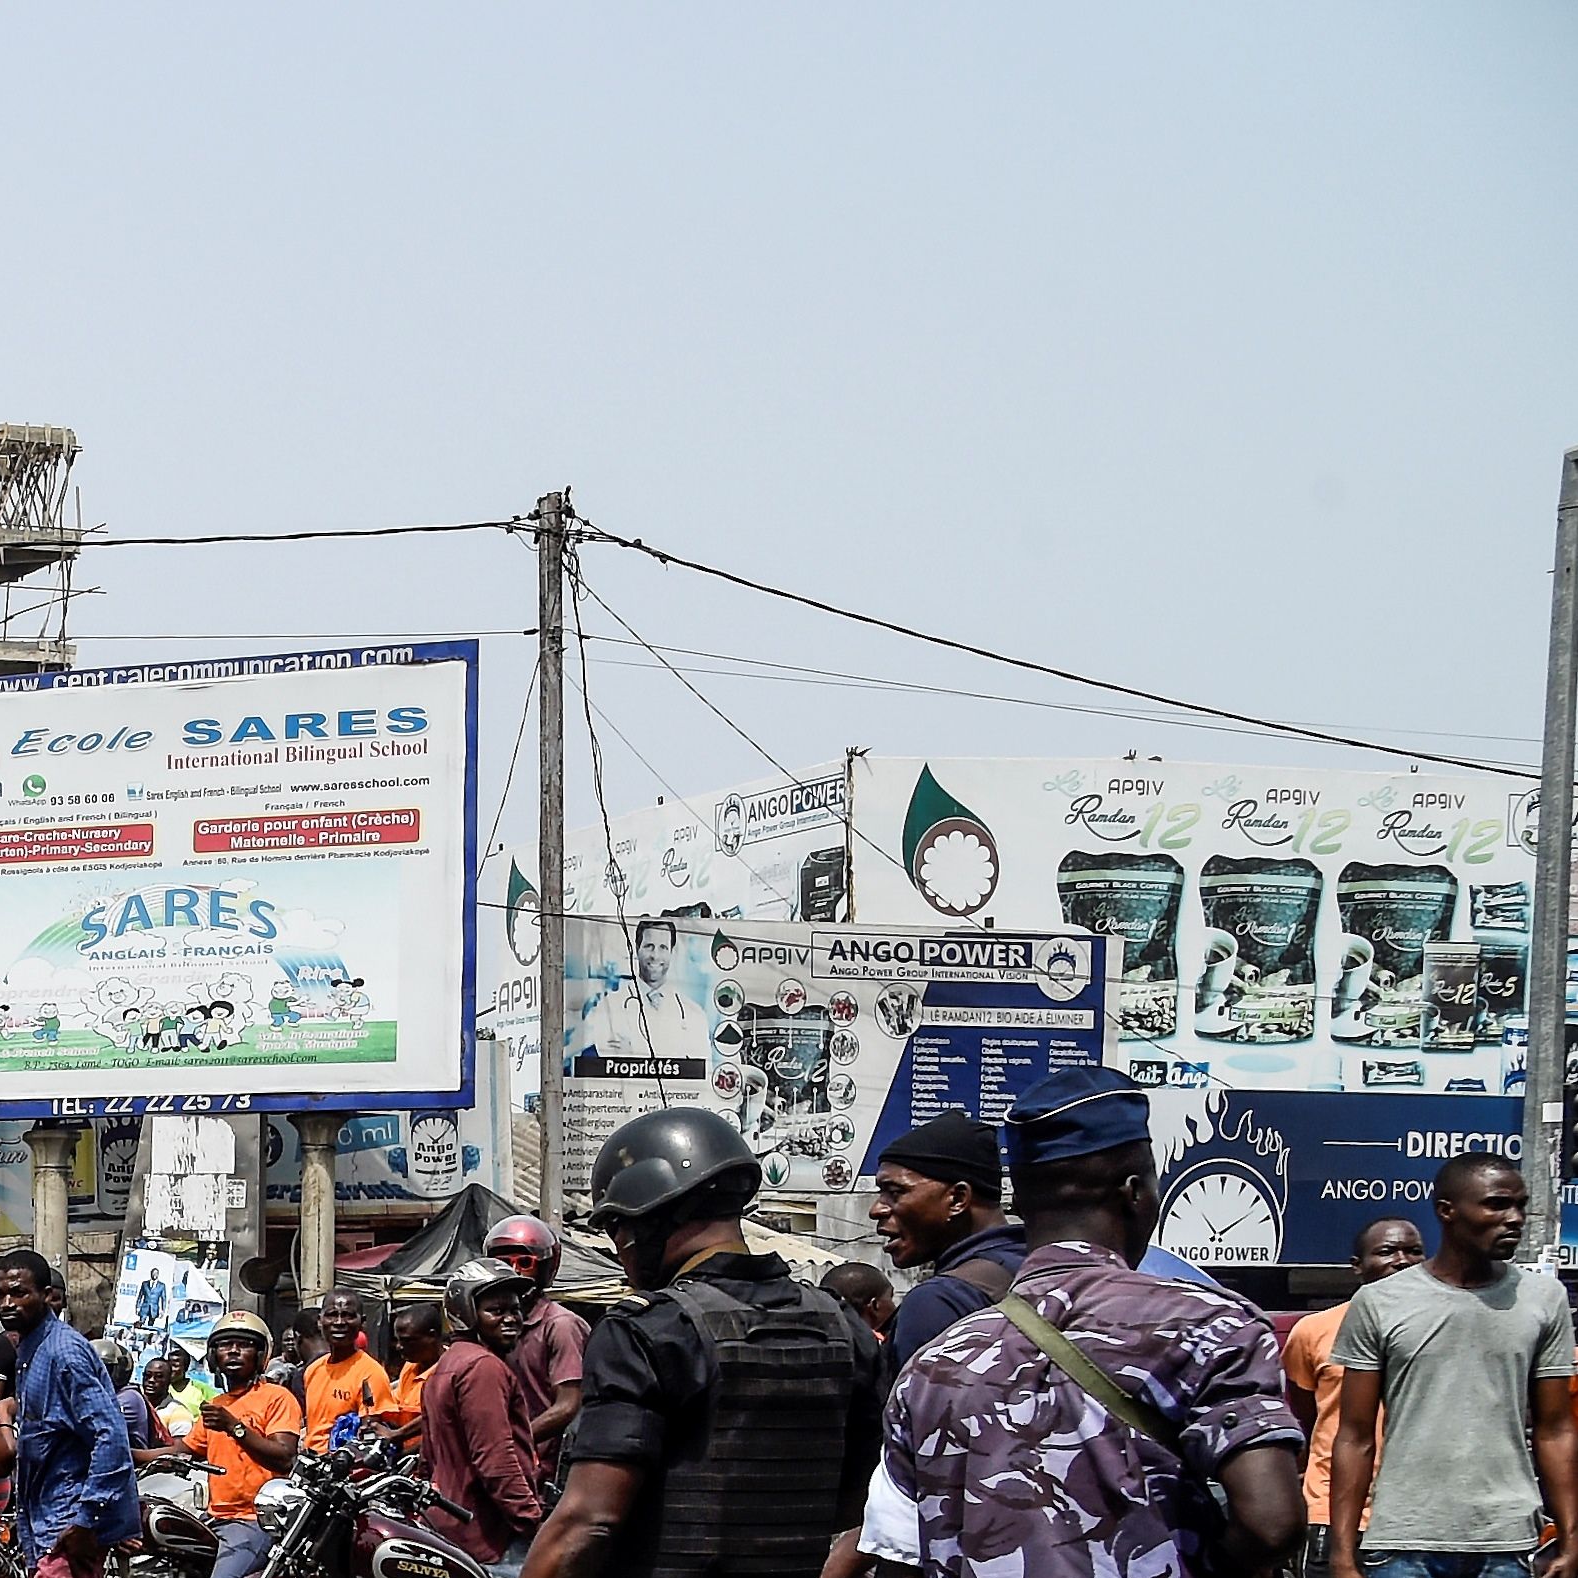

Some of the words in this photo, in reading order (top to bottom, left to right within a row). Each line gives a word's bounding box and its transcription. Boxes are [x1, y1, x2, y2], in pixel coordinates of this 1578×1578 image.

[11, 726, 153, 758] Ecole
[182, 707, 429, 745] SARES
[167, 748, 278, 770] International
[285, 742, 363, 766] Bilingual
[369, 738, 428, 759] School
[189, 788, 202, 797] and
[203, 786, 225, 797] French
[259, 783, 282, 794] School
[291, 776, 430, 793] www.saresschool.com
[265, 801, 303, 811] Français
[313, 799, 345, 808] French
[748, 796, 788, 823] ANGO
[24, 815, 55, 825] English
[58, 814, 74, 823] and
[76, 812, 106, 822] French
[197, 821, 260, 835] Garderie
[263, 819, 298, 833] pour
[301, 815, 348, 829] enfant
[351, 811, 415, 826] (Crèche)
[1064, 794, 1141, 841] Ramdan
[1139, 801, 1201, 850] 12
[1221, 799, 1294, 846] Ramdan
[1292, 807, 1351, 855] 12
[230, 834, 305, 849] Maternelle
[318, 830, 381, 844] Primaire
[1376, 810, 1447, 856] Ramdan
[1445, 817, 1505, 864] 12
[80, 888, 277, 950] SARES
[89, 949, 166, 961] ANGLAIS
[828, 939, 913, 963] ANGO
[924, 941, 1027, 967] POWER
[942, 1011, 992, 1024] RAMDAN12
[997, 1012, 1012, 1024] BIO
[1014, 1012, 1035, 1025] AIDE
[606, 1059, 680, 1077] Propriétés
[1130, 1062, 1162, 1085] Lait
[567, 1090, 623, 1101] Antiparasitaire
[644, 1090, 700, 1102] Antiépresseur
[51, 1099, 94, 1115] TEL:
[567, 1104, 632, 1116] Antihypertenseur
[362, 1121, 393, 1142] ml
[1407, 1132, 1523, 1160] DIRECTIO
[414, 1152, 457, 1164] Power
[1321, 1180, 1387, 1201] ANGO
[1392, 1180, 1435, 1201] POW
[1214, 1247, 1270, 1262] POWER
